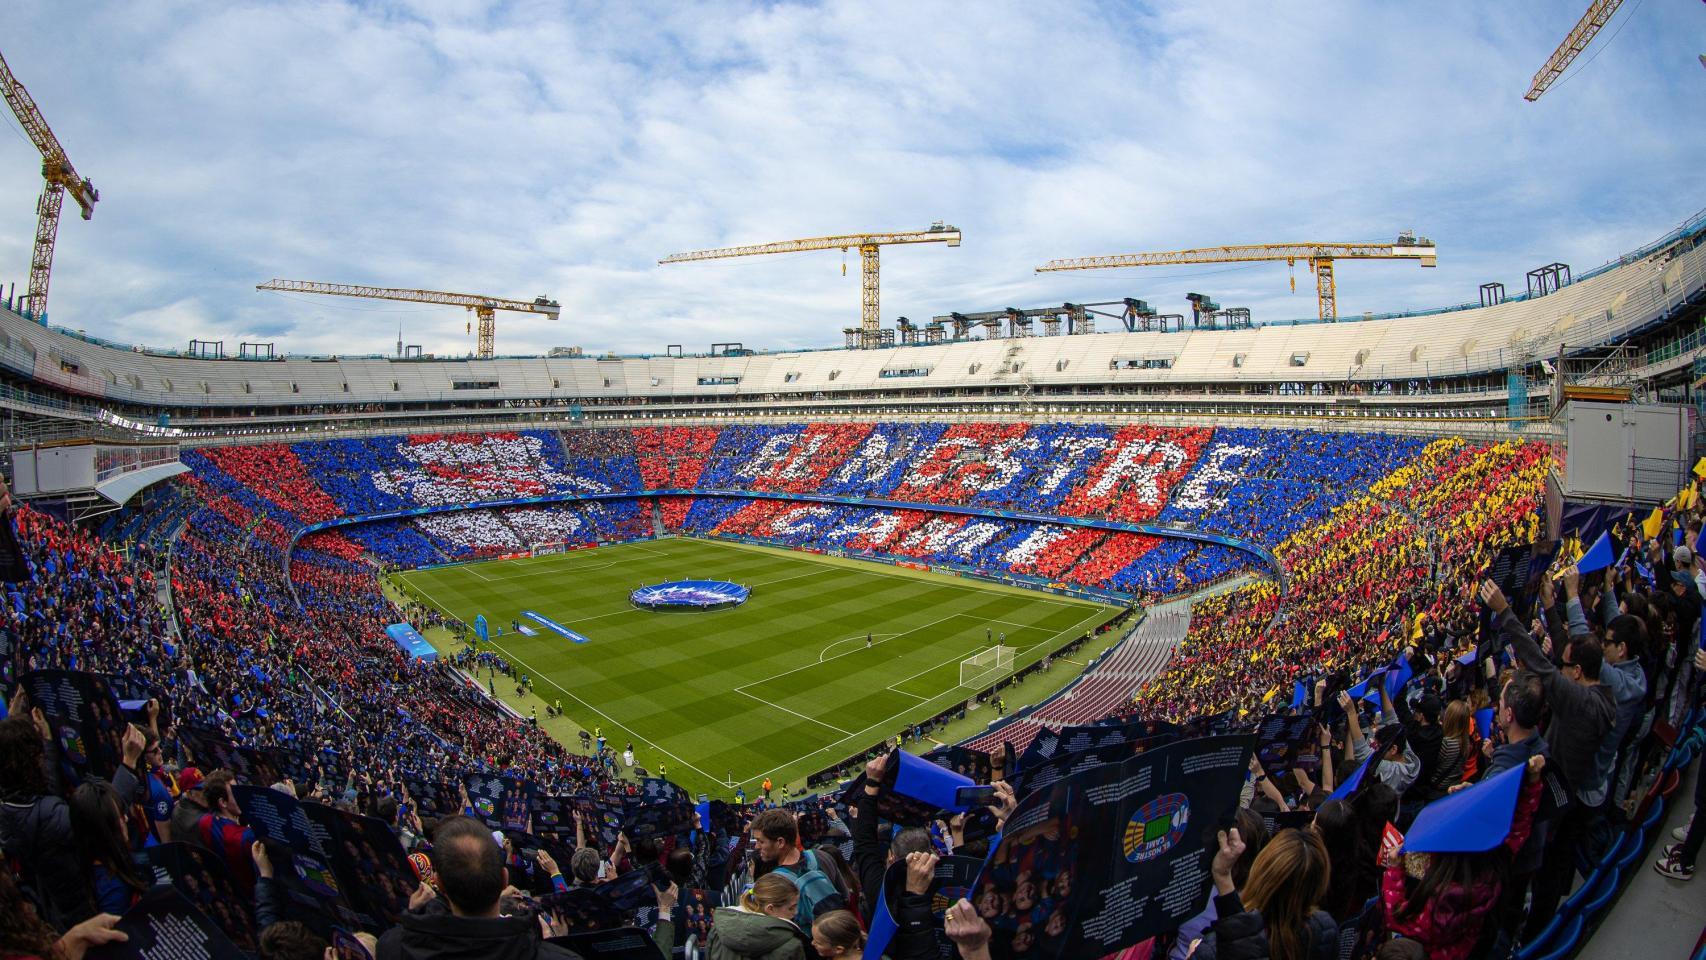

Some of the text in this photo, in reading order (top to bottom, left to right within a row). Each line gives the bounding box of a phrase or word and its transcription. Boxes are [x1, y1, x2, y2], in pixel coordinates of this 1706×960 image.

[737, 433, 1267, 510] EL NOSTRE
[931, 566, 956, 576] Heineken
[1135, 846, 1161, 860] NOSTRE
